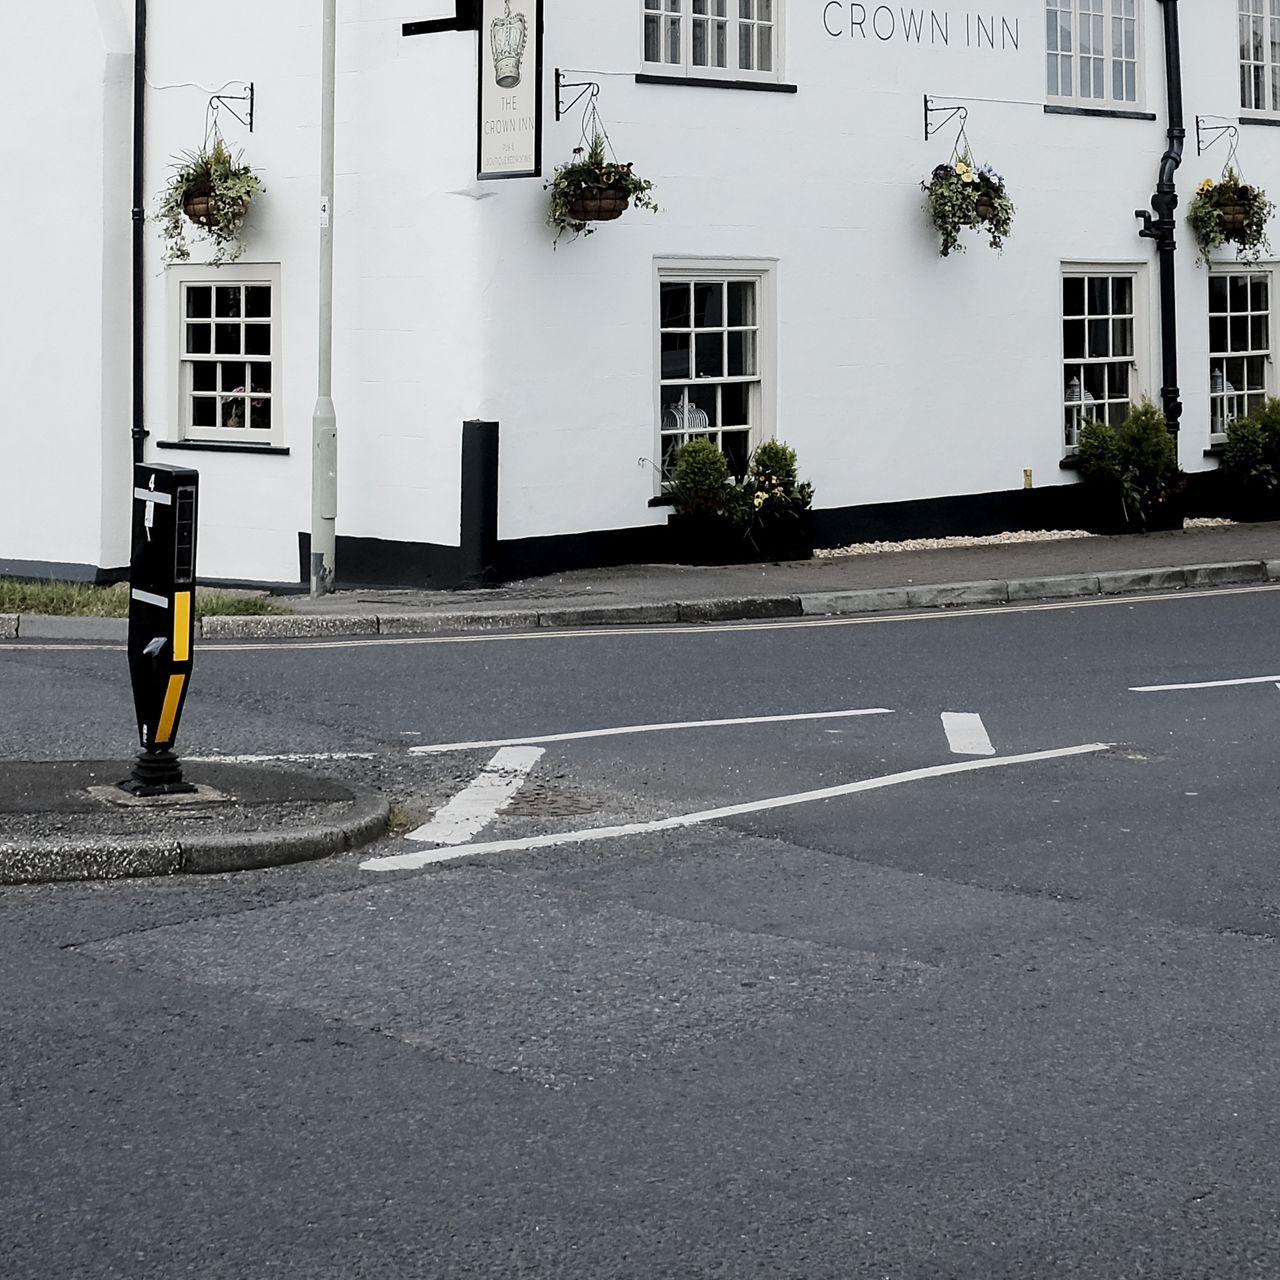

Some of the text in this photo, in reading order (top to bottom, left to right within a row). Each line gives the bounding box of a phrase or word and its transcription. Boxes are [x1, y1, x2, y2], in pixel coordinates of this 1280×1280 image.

[823, 0, 1019, 50] CROWN INN
[501, 95, 517, 111] THE
[484, 116, 534, 135] CROWN INN
[149, 474, 155, 491] 4
